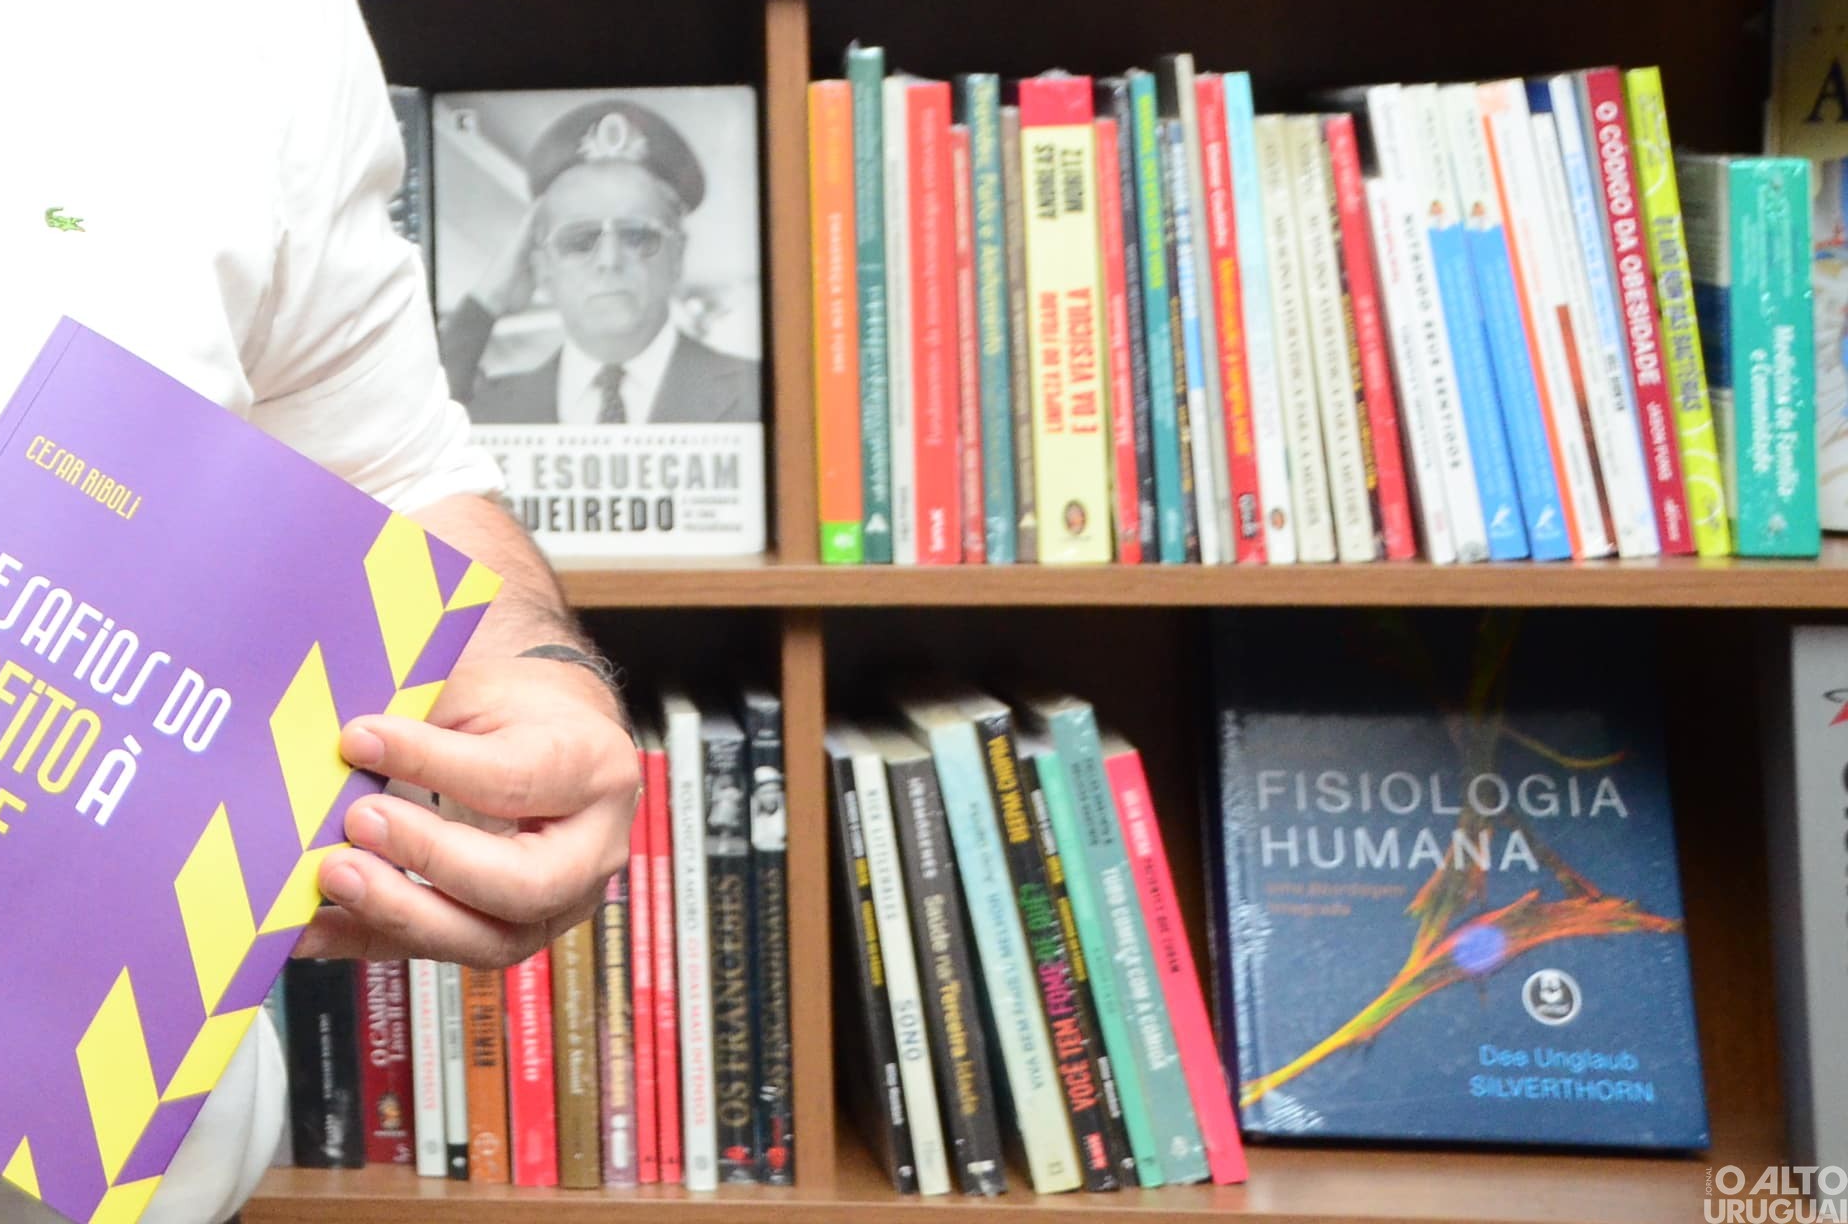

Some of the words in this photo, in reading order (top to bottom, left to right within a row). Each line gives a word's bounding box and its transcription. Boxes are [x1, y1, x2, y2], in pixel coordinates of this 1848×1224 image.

[1595, 101, 1619, 122] O
[1034, 144, 1056, 220] ANDREAS
[1061, 148, 1085, 213] MORITZ
[1596, 125, 1635, 216] CÓDIGO
[1613, 221, 1642, 252] DA
[1038, 292, 1061, 342] FÍGADO
[1065, 287, 1095, 381] VESÍCULA
[1619, 255, 1662, 387] OBESIDADE
[1041, 346, 1062, 368] DO
[1668, 334, 1704, 413] BACTÉRIAS
[1751, 349, 1771, 362] e
[1769, 325, 1797, 404] Medicina
[1042, 372, 1064, 434] LIMPEZA
[1070, 386, 1097, 416] DA
[1645, 402, 1668, 441] JASON
[1748, 365, 1776, 474] Comunidade
[1774, 408, 1797, 430] de
[1074, 422, 1098, 434] E
[24, 435, 87, 486] CESAR
[1651, 443, 1673, 481] FUNG
[1773, 433, 1802, 497] Família
[152, 666, 233, 753] DO
[75, 733, 144, 826] À
[987, 734, 1019, 788] CHOPRA
[998, 790, 1032, 843] DEEPAK
[1257, 769, 1629, 819] FISIOLOGIA
[679, 780, 697, 874] ROSANGELA
[1260, 826, 1540, 873] HUMANA
[682, 879, 700, 932] MORO
[1100, 866, 1126, 907] TUDO
[866, 789, 887, 822] NICK
[894, 998, 922, 1063] SONO
[924, 894, 953, 953] Saúde
[1032, 930, 1057, 962] DE
[1107, 907, 1141, 970] COMEÇA
[687, 963, 703, 1001] DIAS
[712, 872, 750, 1073] FRANCESES
[1039, 962, 1075, 1016] FOME
[1124, 971, 1151, 1001] COM
[689, 1004, 705, 1043] MAIS
[938, 980, 975, 1058] Terceira
[1054, 1017, 1084, 1059] TEM
[1139, 1016, 1168, 1071] COMIDA
[371, 1052, 387, 1066] O
[1479, 1044, 1526, 1069] Dee
[1533, 1047, 1639, 1075] Unglaub
[691, 1046, 709, 1127] INTENSOS
[719, 1081, 751, 1128] OS
[1060, 1061, 1098, 1113] VOCÊ
[1468, 1076, 1655, 1104] SILVERTHORN
